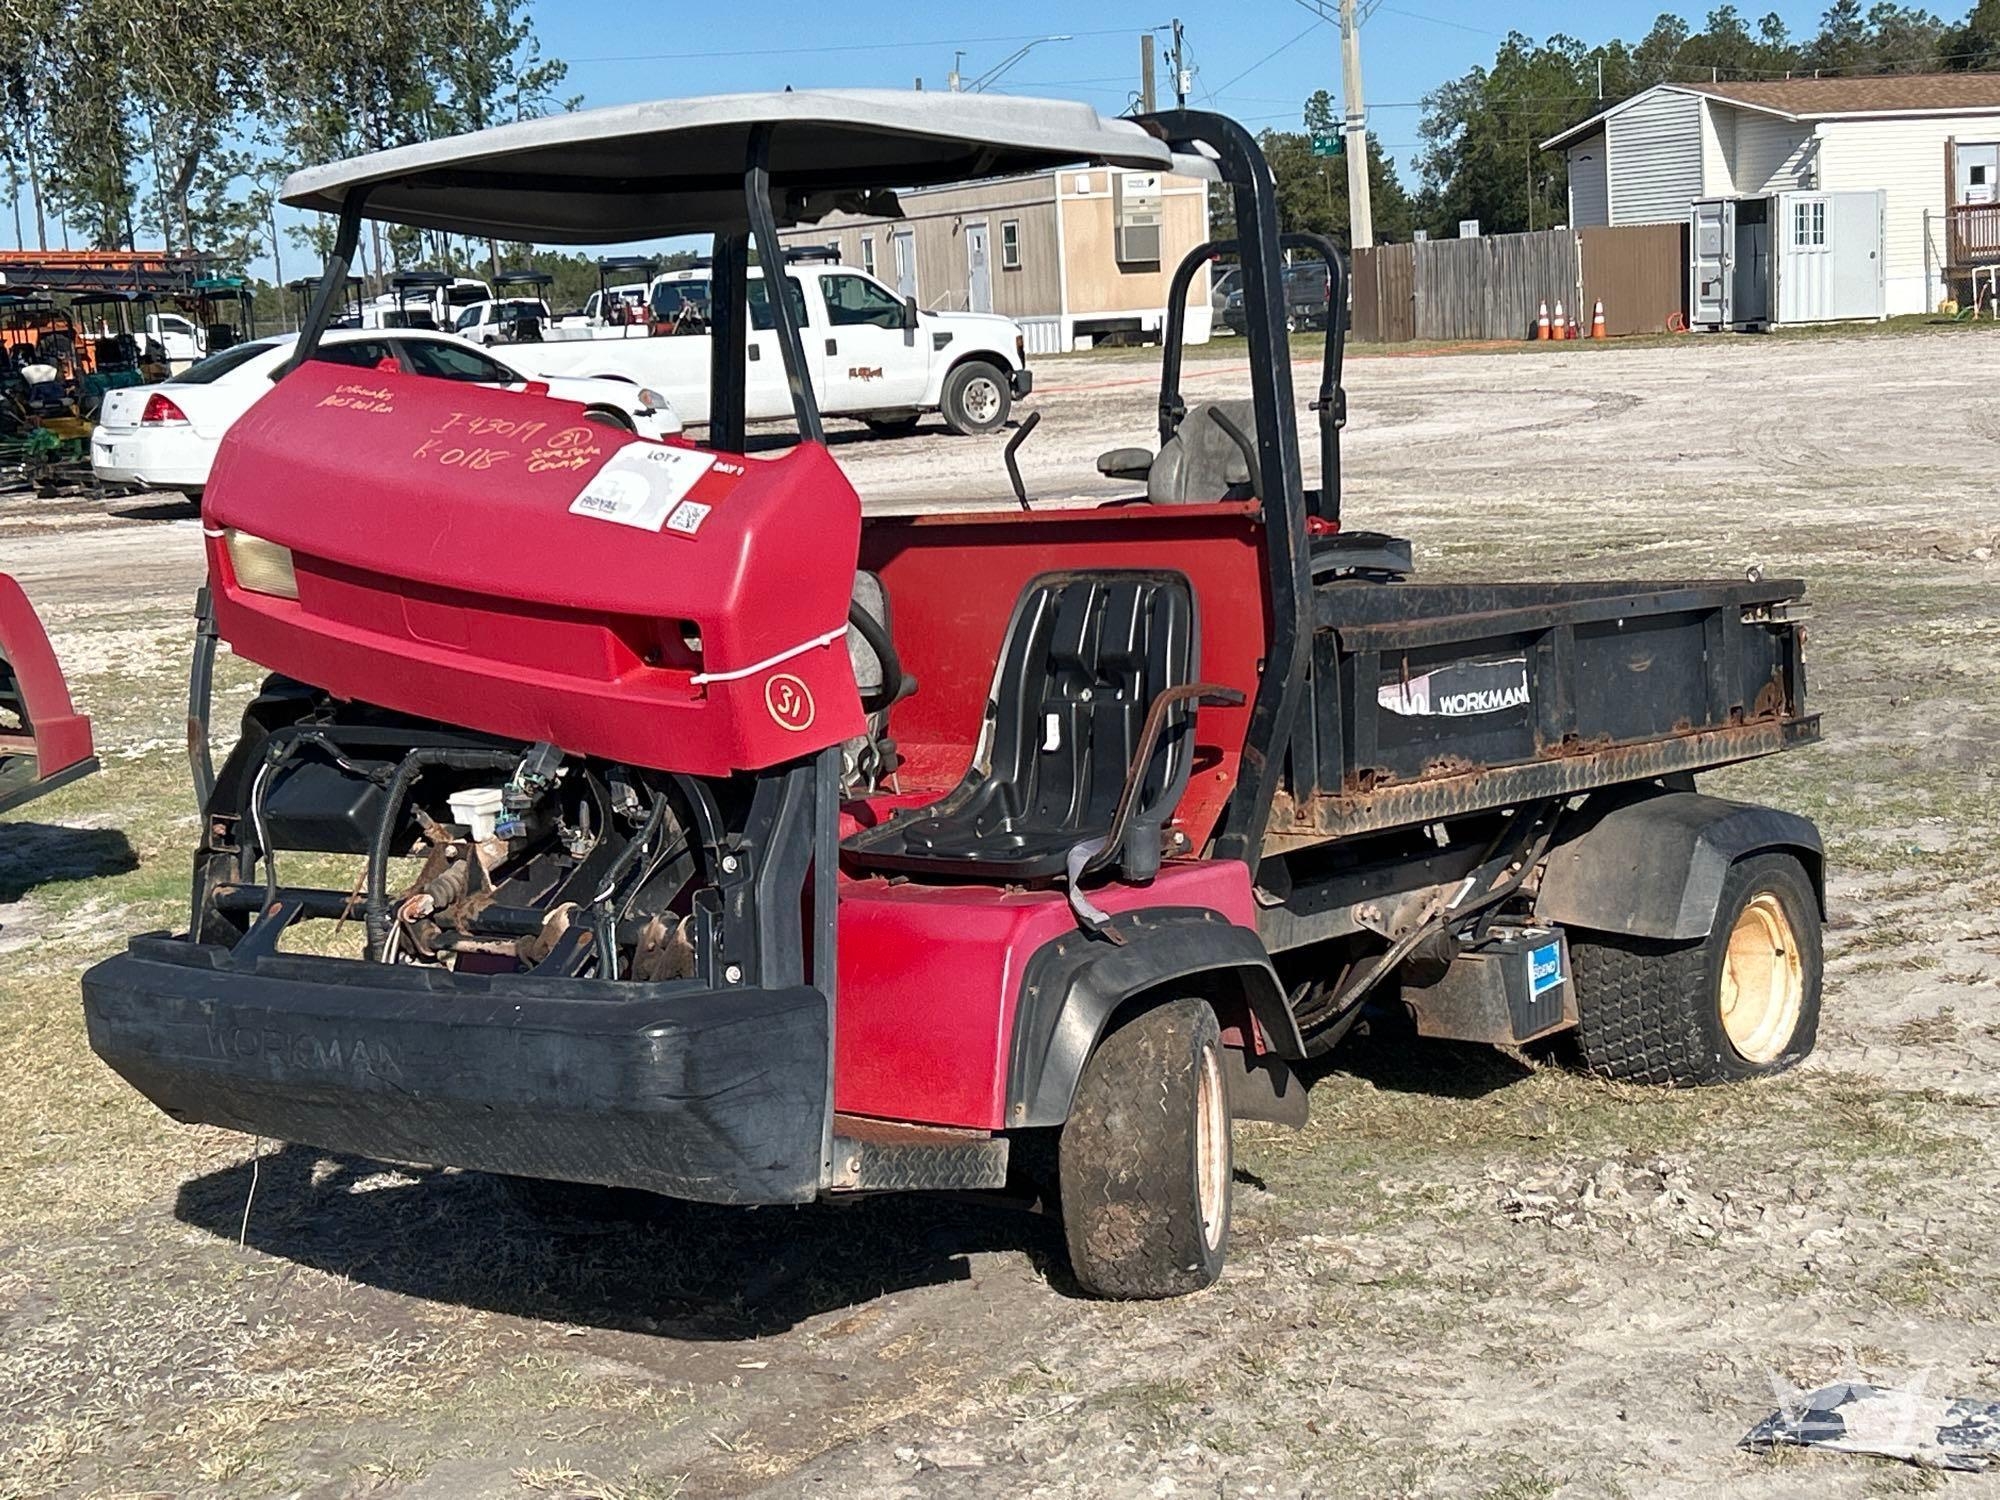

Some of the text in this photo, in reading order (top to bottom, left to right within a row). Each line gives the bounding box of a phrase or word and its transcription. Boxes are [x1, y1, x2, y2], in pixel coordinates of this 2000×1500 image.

[647, 451, 672, 462] LOT
[713, 462, 737, 474] DAY
[581, 495, 618, 511] ROYAL
[778, 685, 801, 717] 31
[1439, 686, 1528, 714] WORKMAN
[203, 1023, 403, 1077] WORKMAN
